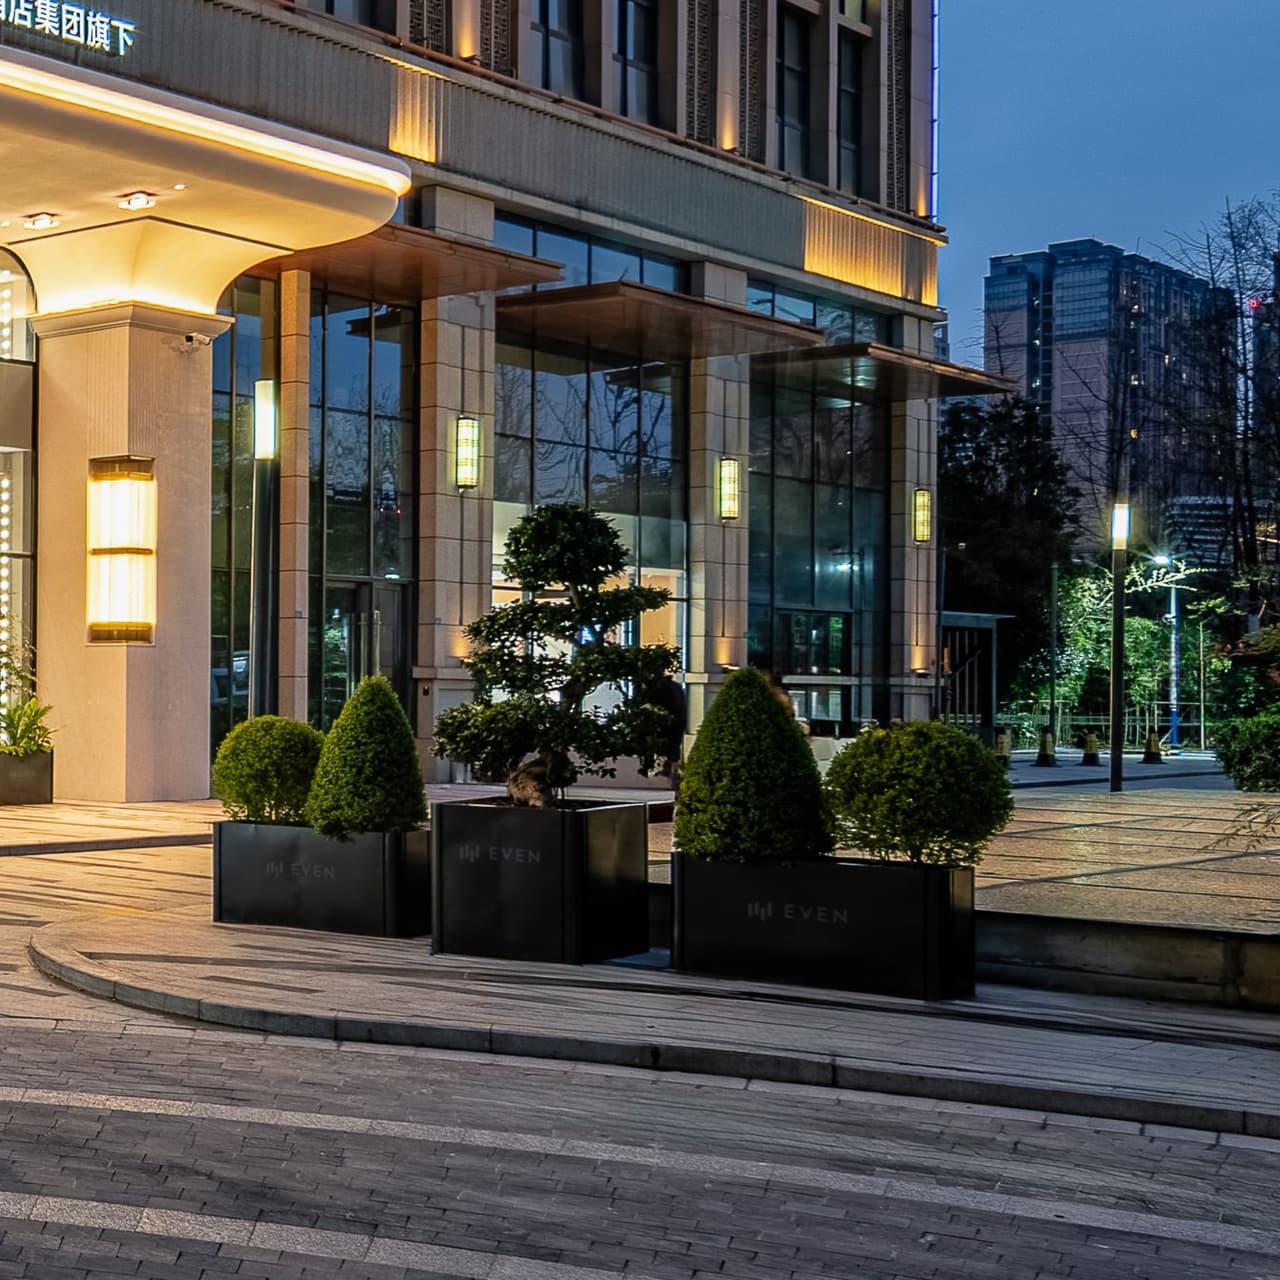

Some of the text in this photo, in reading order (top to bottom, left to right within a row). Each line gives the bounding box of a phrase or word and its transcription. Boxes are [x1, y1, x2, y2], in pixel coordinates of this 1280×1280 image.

[488, 846, 542, 864] EVEN
[290, 863, 336, 879] EVEN
[783, 903, 849, 924] EVEN
